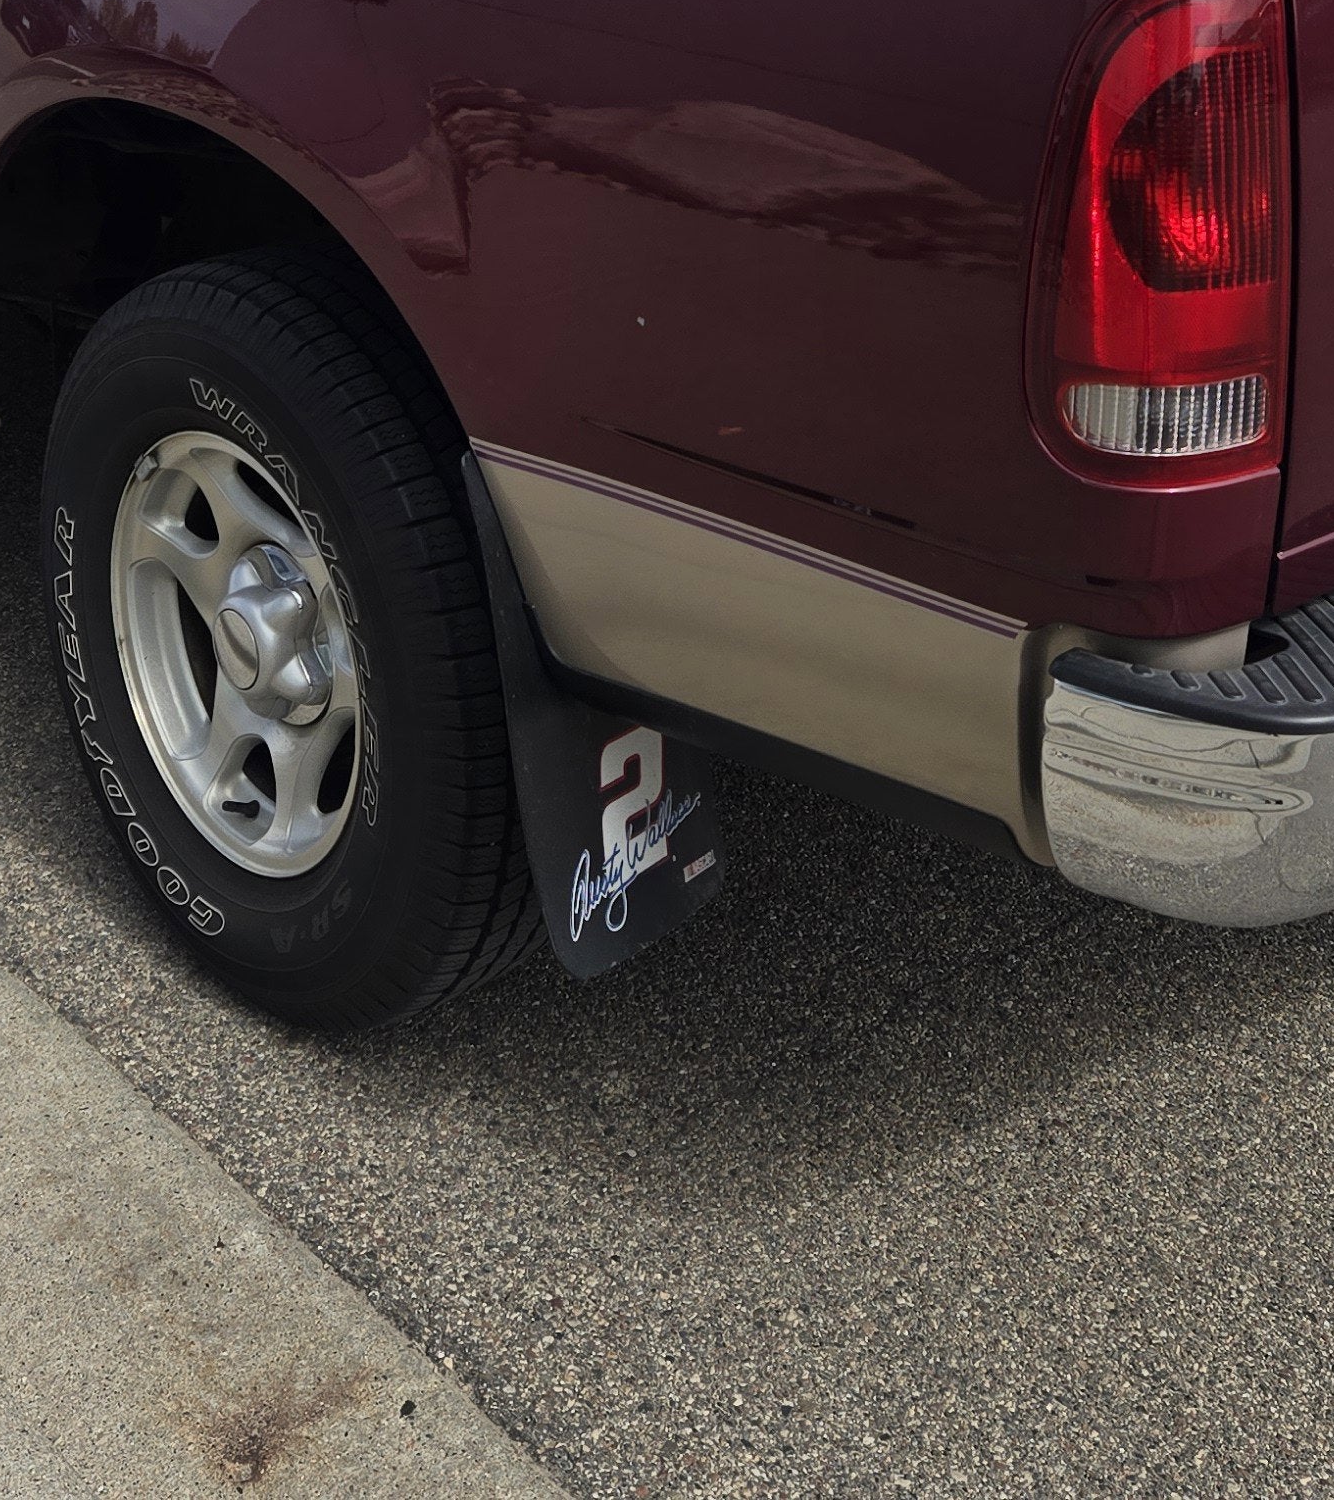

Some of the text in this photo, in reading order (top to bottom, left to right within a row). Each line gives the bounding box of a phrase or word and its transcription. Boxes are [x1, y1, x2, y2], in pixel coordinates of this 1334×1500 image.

[54, 506, 226, 936] GOODYEAR
[189, 377, 379, 827] WRANGLER
[599, 725, 668, 875] 2
